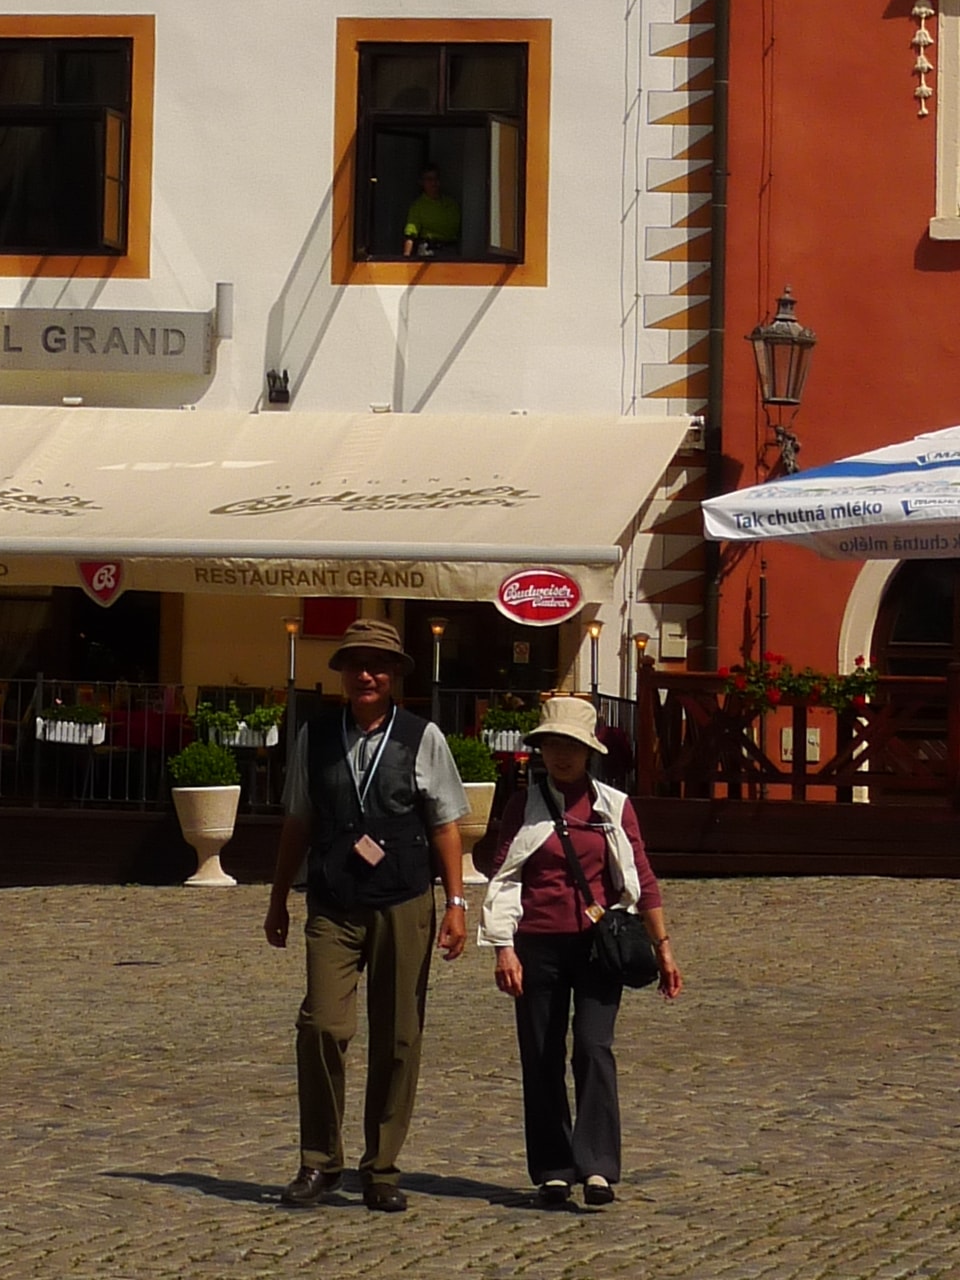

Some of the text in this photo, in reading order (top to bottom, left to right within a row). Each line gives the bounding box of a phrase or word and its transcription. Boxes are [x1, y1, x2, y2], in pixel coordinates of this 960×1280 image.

[41, 325, 187, 356] GRAND
[209, 485, 541, 516] Budweiser
[733, 500, 883, 529] Tak chutná mléko
[195, 567, 425, 589] RESTAURANT GRAND
[503, 582, 575, 605] Budweiser
